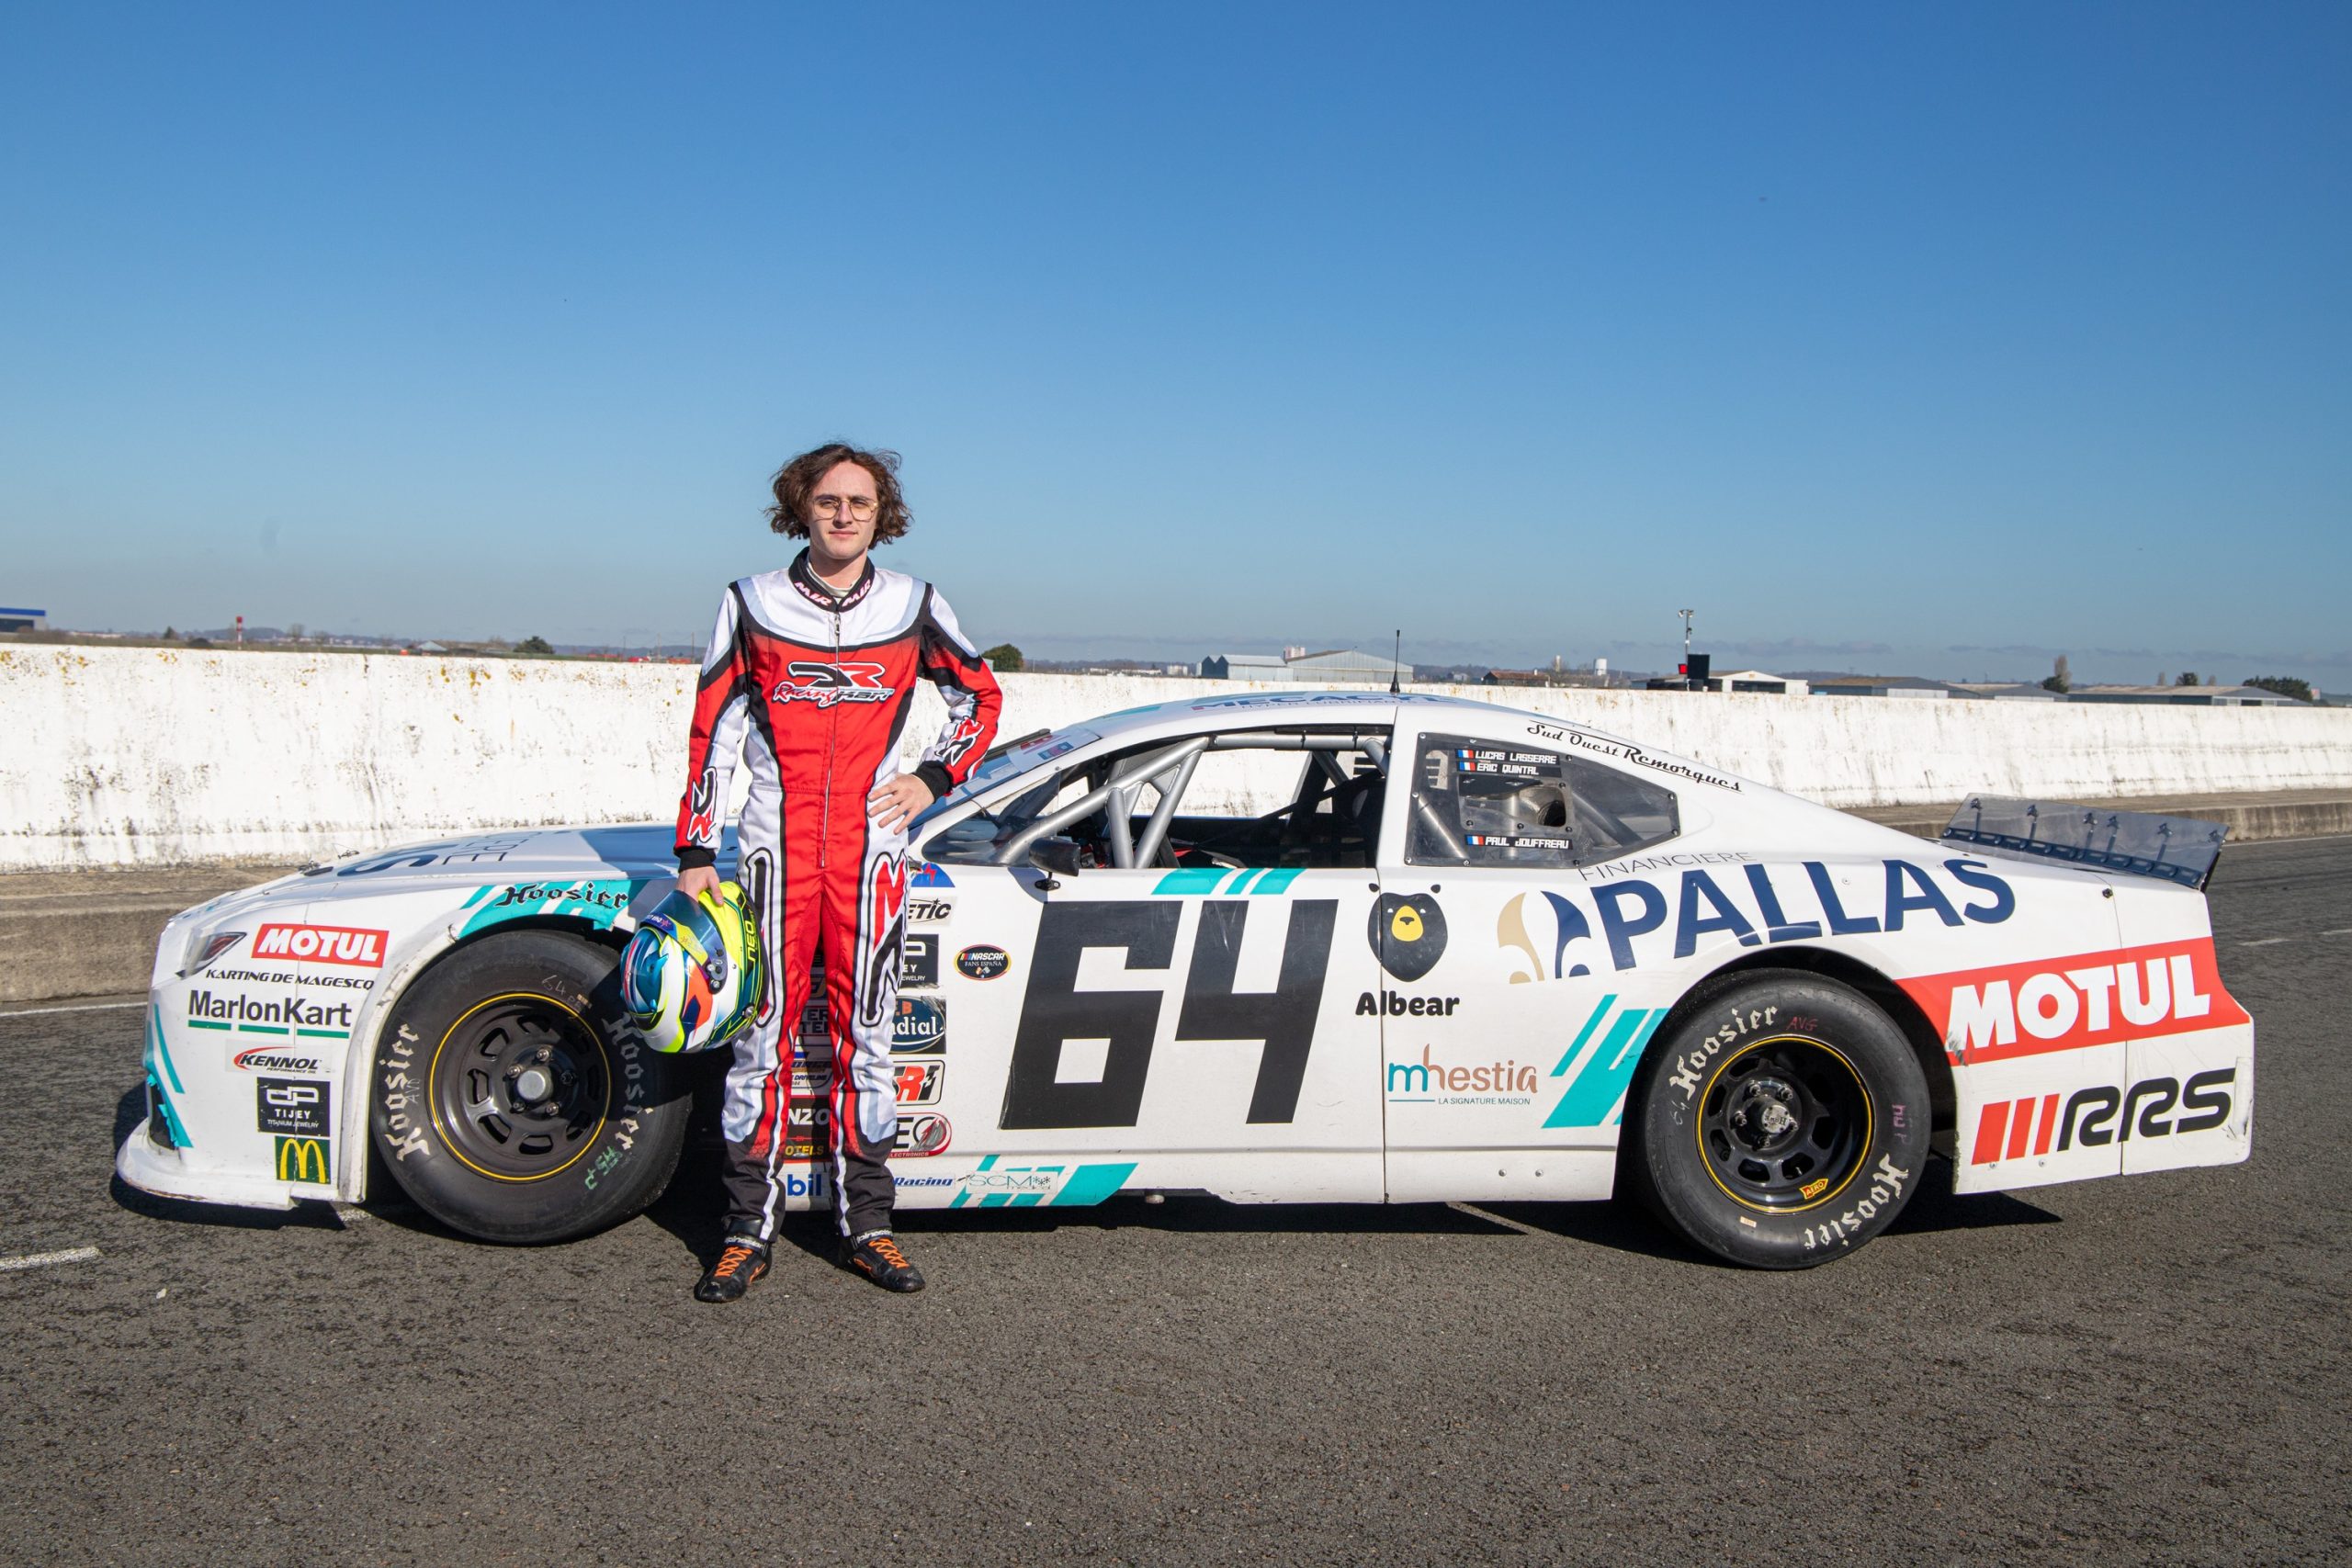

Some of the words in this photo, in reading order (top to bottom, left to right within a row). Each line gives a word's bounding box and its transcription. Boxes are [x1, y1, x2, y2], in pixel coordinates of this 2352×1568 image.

[1476, 750, 1506, 761] LUCAS
[1510, 752, 1557, 764] LASSERRE
[1527, 723, 1563, 741] Sud
[1569, 732, 1619, 757] Ouest
[1623, 747, 1742, 793] Remorques
[1476, 763, 1498, 773] ERIC
[1502, 764, 1539, 775] QUINTAL
[1485, 836, 1510, 846] PAUL
[1514, 837, 1569, 850] JOUFFREAU
[1577, 852, 1758, 881] FINANCIERE
[494, 882, 628, 908] Hoosier
[908, 903, 952, 919] ETIC
[1589, 859, 2016, 972] PALLAS
[257, 928, 380, 962] MOTUL
[971, 953, 1004, 961] NASCAR
[205, 969, 270, 982] KARTING
[271, 973, 294, 984] DE
[295, 975, 375, 990] MAGESCQ
[188, 989, 353, 1028] MarlonKart
[1355, 990, 1460, 1017] Albear
[1945, 953, 2211, 1053] MOTUL
[893, 1016, 938, 1035] dial
[998, 898, 1340, 1131] 64
[239, 1055, 319, 1070] KENNOL
[1669, 1006, 1778, 1100] Hoosier
[379, 1022, 431, 1161] Hoosier
[601, 1011, 654, 1150] Hoosier
[1438, 1097, 1449, 1105] LA
[1450, 1098, 1497, 1106] SIGNATURE
[1498, 1098, 1531, 1106] MAISON
[2056, 1067, 2236, 1152] RRS
[267, 1119, 293, 1127] TITANIUM
[292, 1120, 320, 1128] JEWELRY
[275, 1109, 311, 1120] TIJEY
[787, 1108, 831, 1125] NZO
[785, 1145, 824, 1156] OTELS
[787, 1174, 822, 1196] bil
[894, 1177, 954, 1187] Racing
[1804, 1153, 1909, 1250] Hoosier
